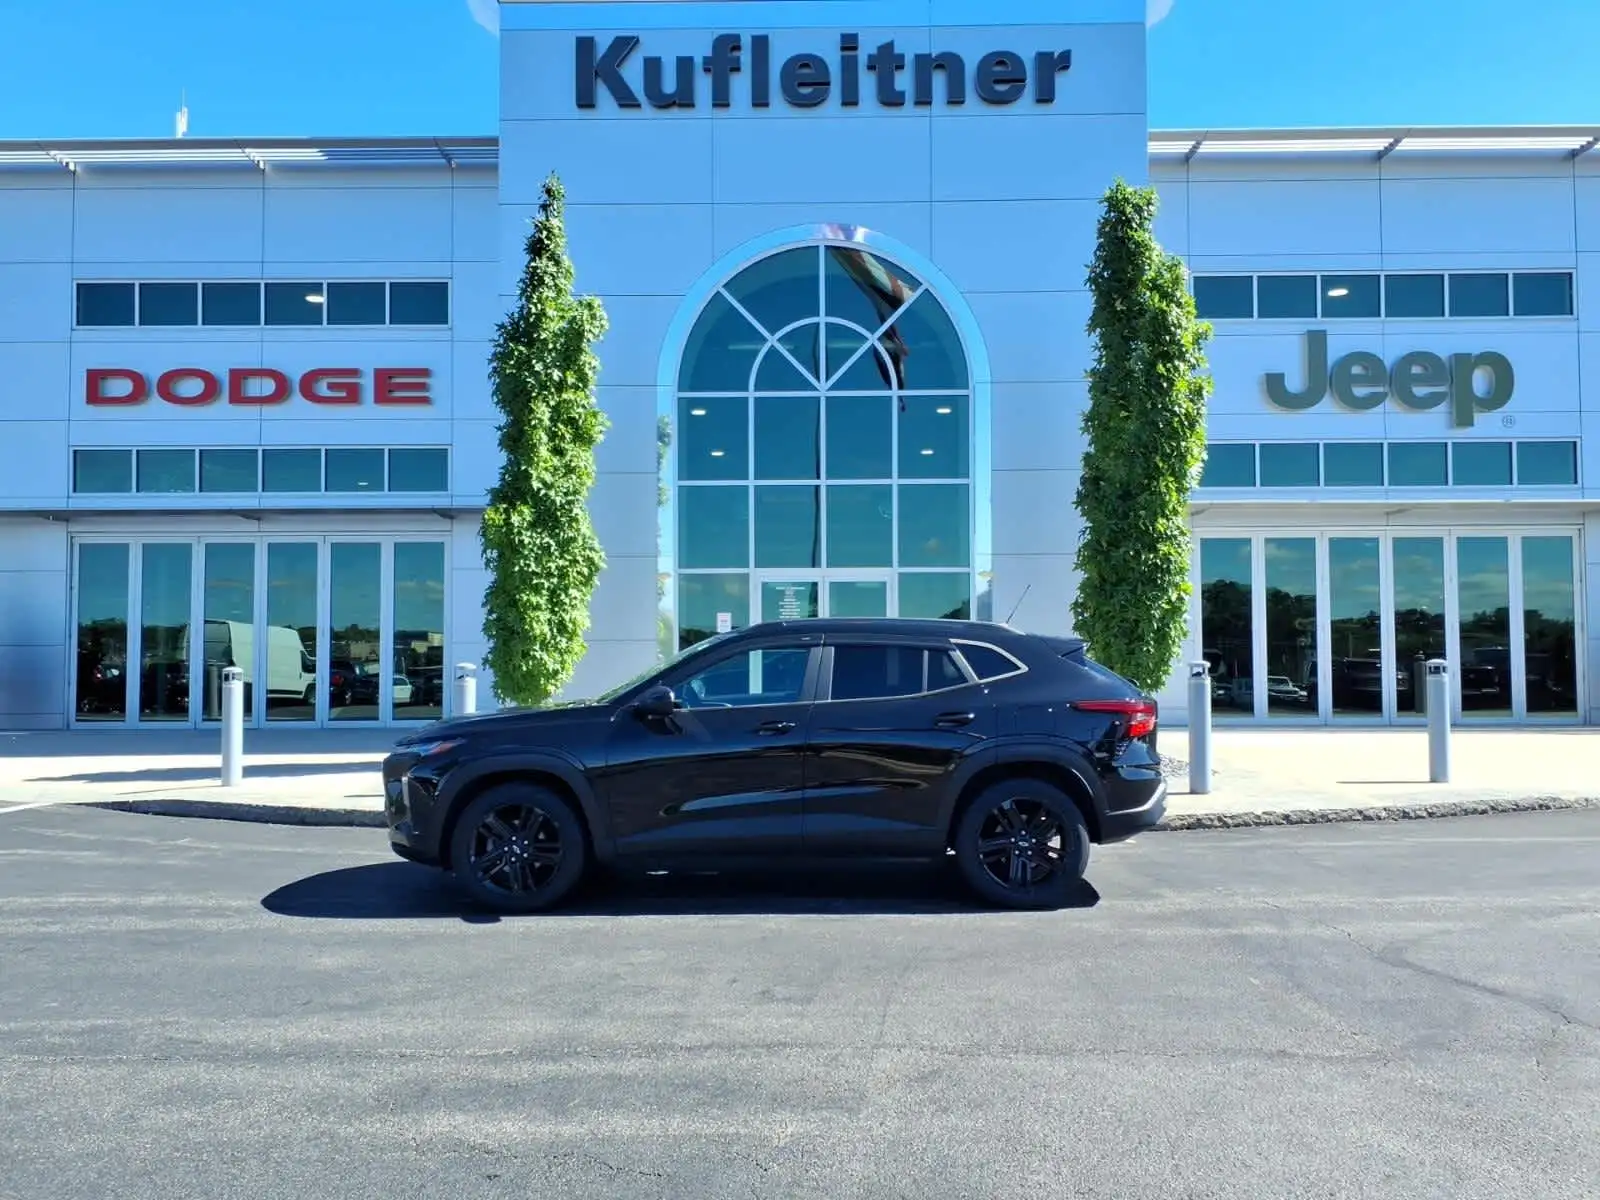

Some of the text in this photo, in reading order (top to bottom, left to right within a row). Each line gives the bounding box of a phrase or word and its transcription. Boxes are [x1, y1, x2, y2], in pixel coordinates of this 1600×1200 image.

[575, 33, 1072, 109] Kufleitner
[85, 367, 433, 406] DODGE
[1263, 329, 1515, 428] Jeep
